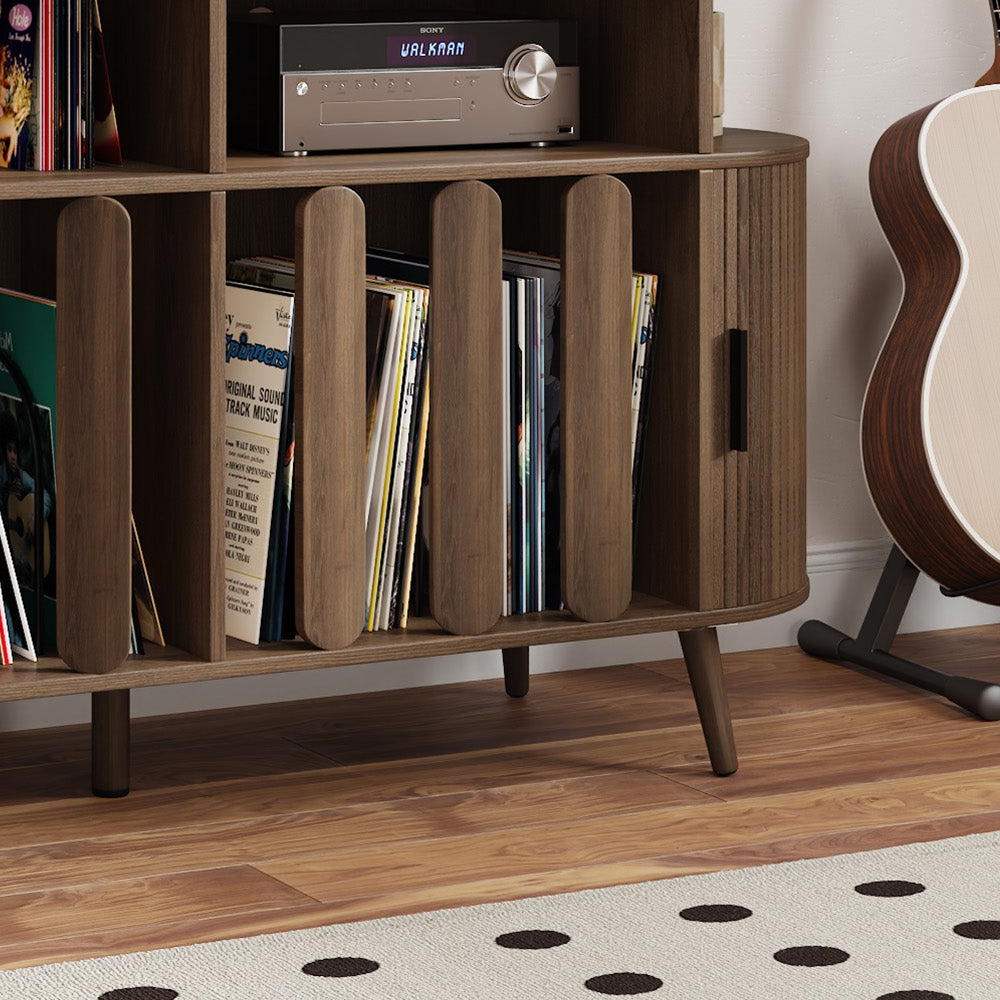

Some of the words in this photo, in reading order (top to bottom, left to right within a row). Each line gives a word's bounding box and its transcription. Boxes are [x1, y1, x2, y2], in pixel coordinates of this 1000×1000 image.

[11, 6, 29, 28] Hole
[401, 41, 465, 57] WALKMAN
[259, 387, 285, 406] SOUND
[226, 398, 251, 418] TRACK
[253, 404, 278, 424] MUSIC
